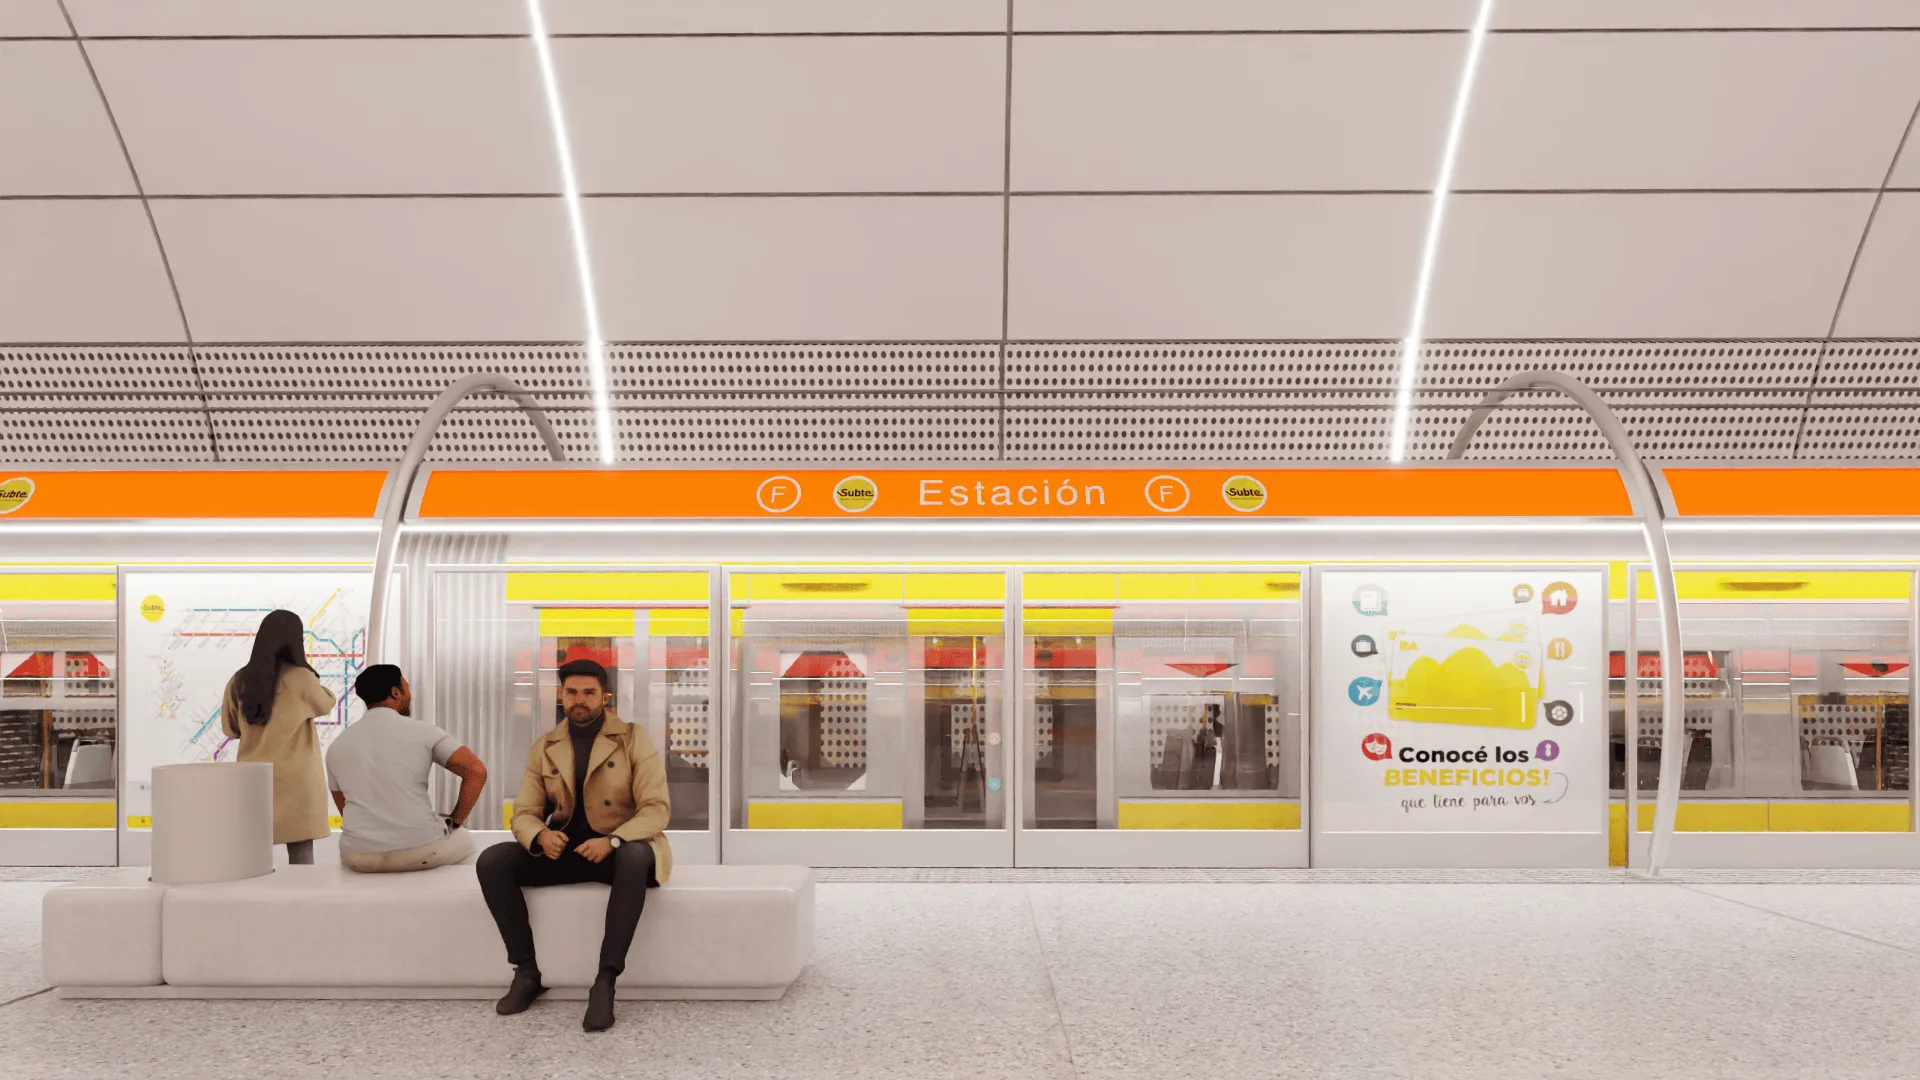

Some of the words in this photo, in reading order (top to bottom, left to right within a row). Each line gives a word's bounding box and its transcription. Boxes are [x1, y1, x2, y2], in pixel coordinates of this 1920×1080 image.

[770, 485, 787, 503] F
[837, 488, 874, 497] Subte
[919, 479, 1106, 506] Estación
[1159, 485, 1174, 503] F
[1226, 487, 1264, 497] Subte
[1399, 745, 1488, 763] Conocé
[1495, 746, 1530, 763] los
[1384, 768, 1551, 787] BENEFICIOS!
[1401, 797, 1427, 813] que
[1433, 794, 1467, 809] tiene
[1473, 794, 1509, 811] para
[1514, 793, 1537, 807] vos
